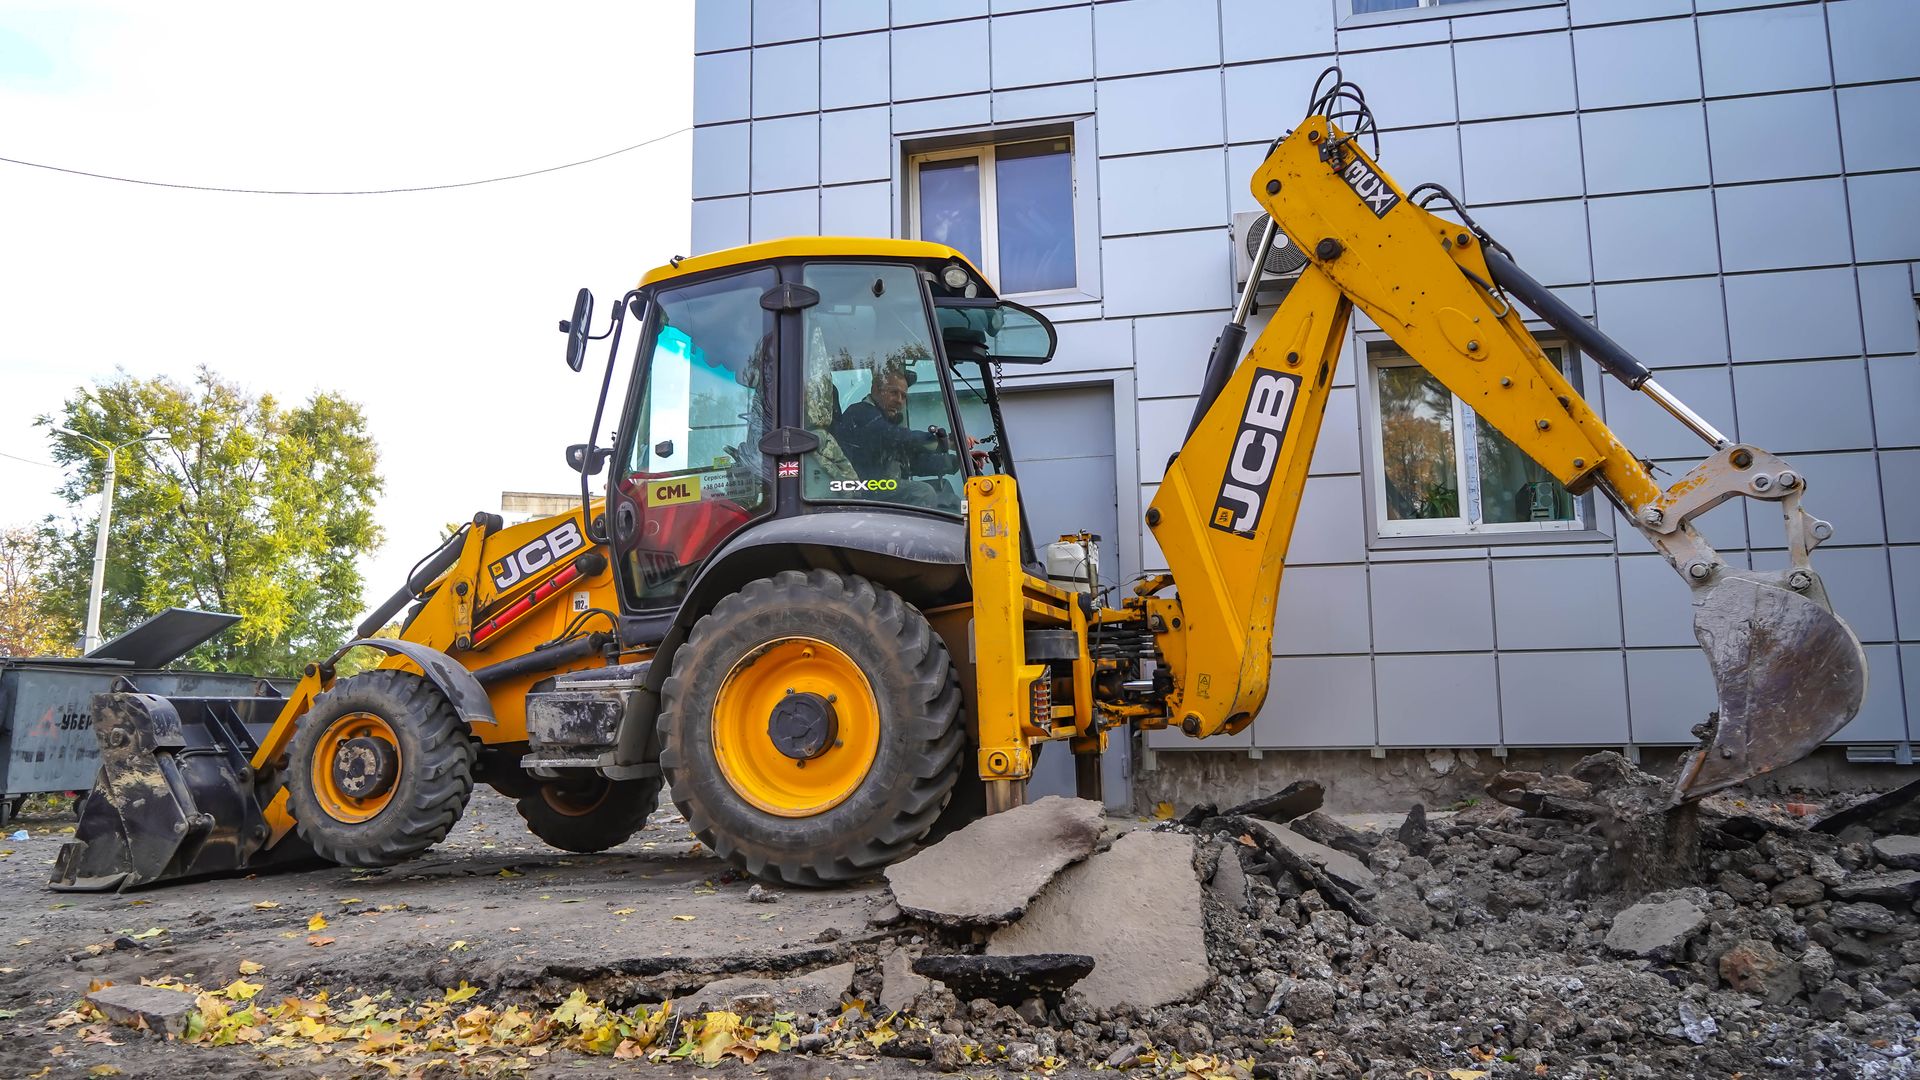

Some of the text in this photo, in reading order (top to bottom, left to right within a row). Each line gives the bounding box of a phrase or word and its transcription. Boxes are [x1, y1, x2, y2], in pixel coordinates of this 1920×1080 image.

[1344, 160, 1395, 213] 3CX
[1222, 374, 1295, 532] JCB
[656, 484, 691, 501] CML
[830, 479, 898, 491] 3CXeco
[496, 522, 582, 588] JCB
